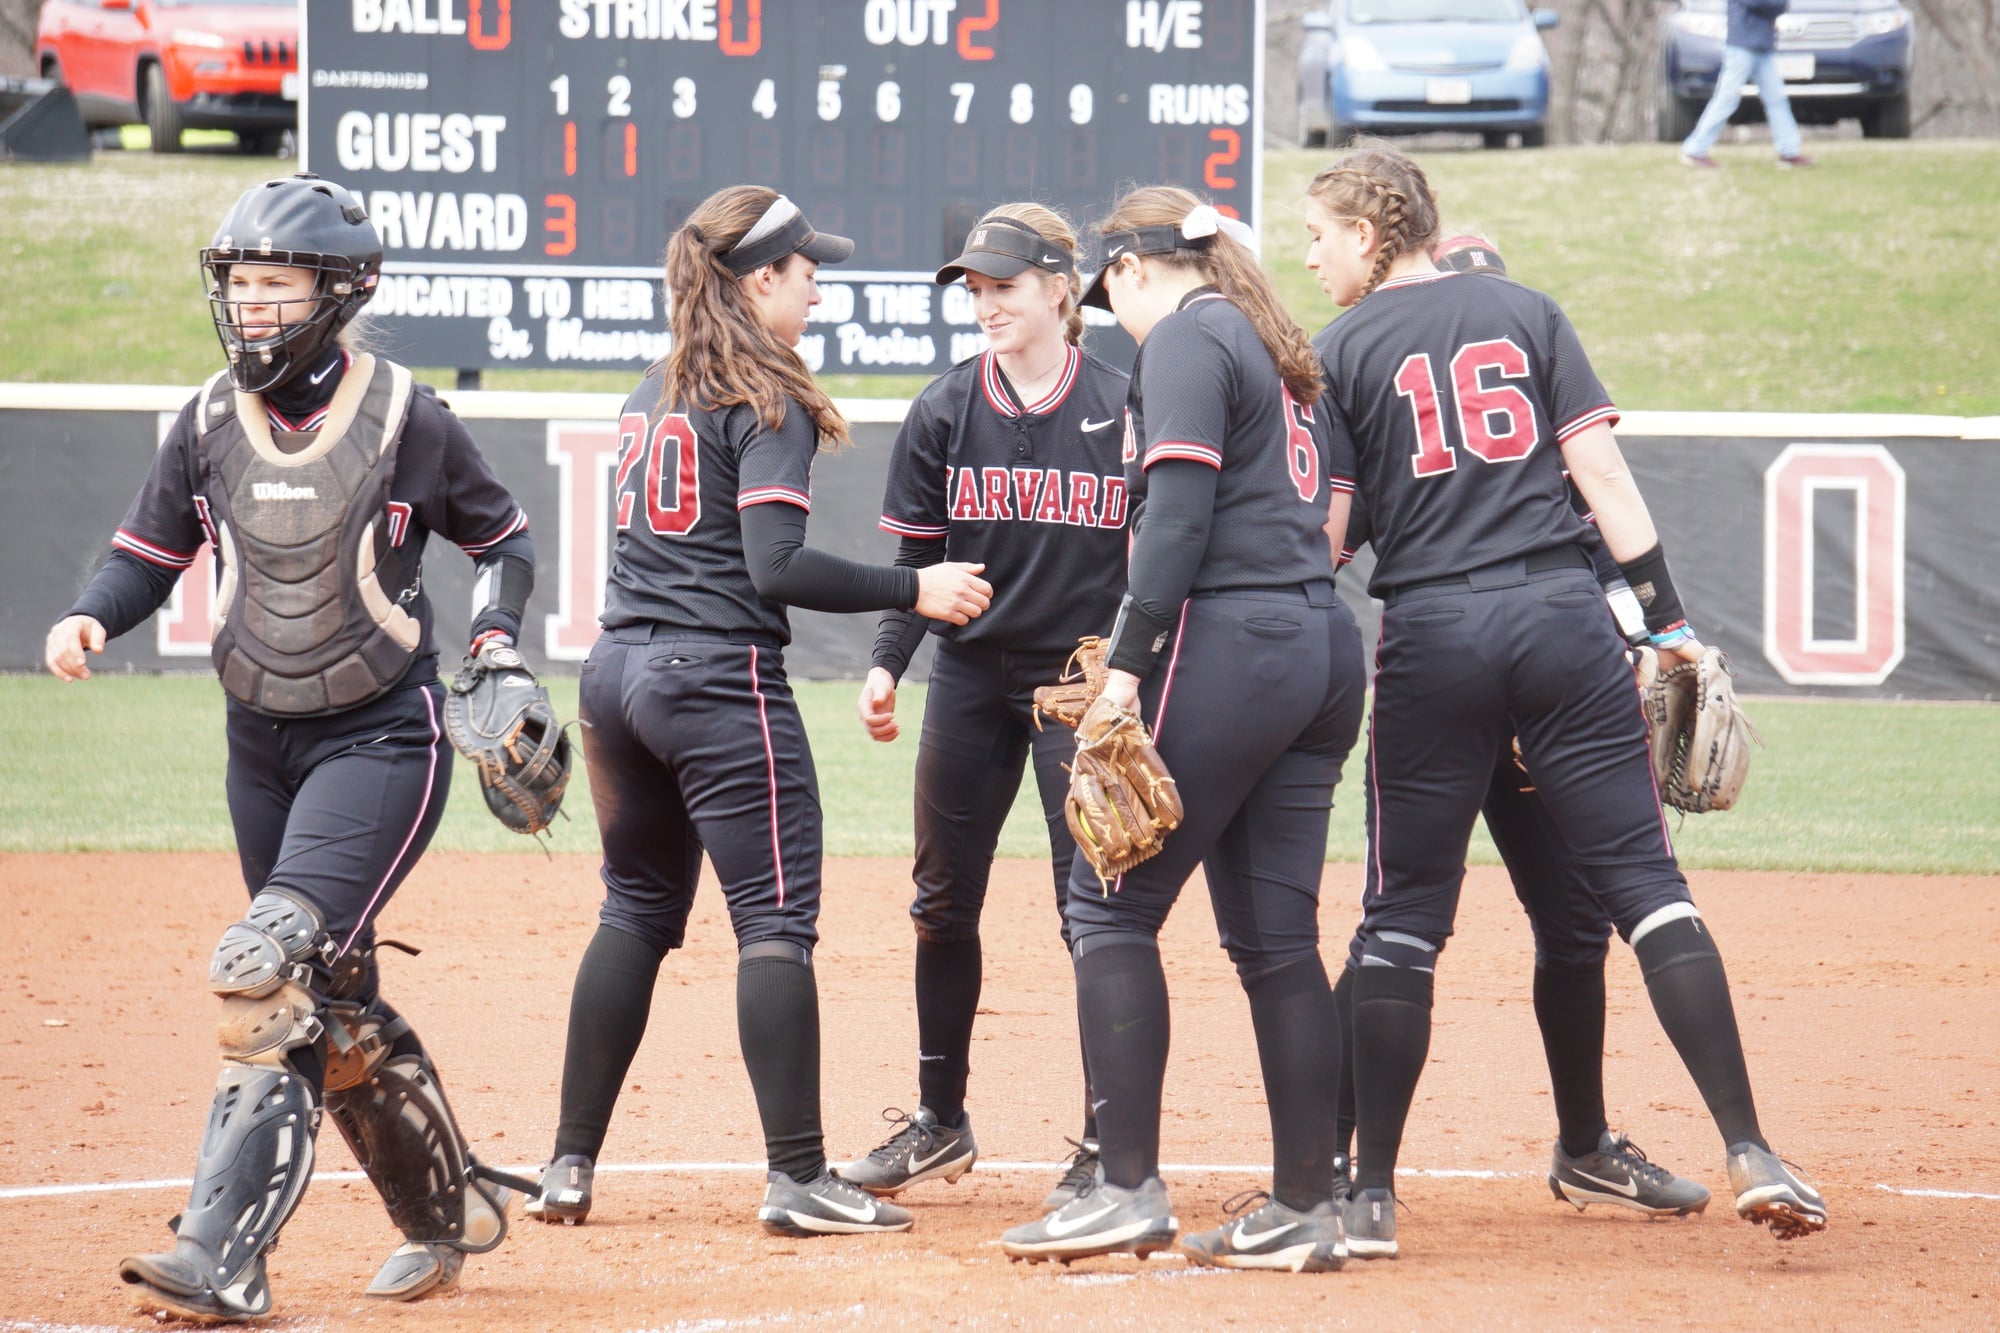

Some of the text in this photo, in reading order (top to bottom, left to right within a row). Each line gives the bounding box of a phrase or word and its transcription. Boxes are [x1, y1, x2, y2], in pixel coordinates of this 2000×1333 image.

[352, 0, 466, 34] BALL
[559, 0, 717, 41] STRIKE
[864, 0, 957, 46] OUT
[957, 0, 999, 60] 2
[1126, 0, 1203, 52] H/E
[550, 74, 1249, 126] 1 2 3 4 5 6 7 8 9 RUNS
[337, 110, 1241, 189] GUEST 1 1 2
[544, 194, 577, 257] 3
[1471, 251, 1488, 267] H
[524, 278, 571, 319] TO
[582, 280, 655, 320] HER
[863, 285, 931, 325] THE
[1394, 338, 1539, 479] 16
[1281, 377, 1319, 503] 6
[252, 481, 319, 501] Wilson
[615, 411, 701, 535] 20
